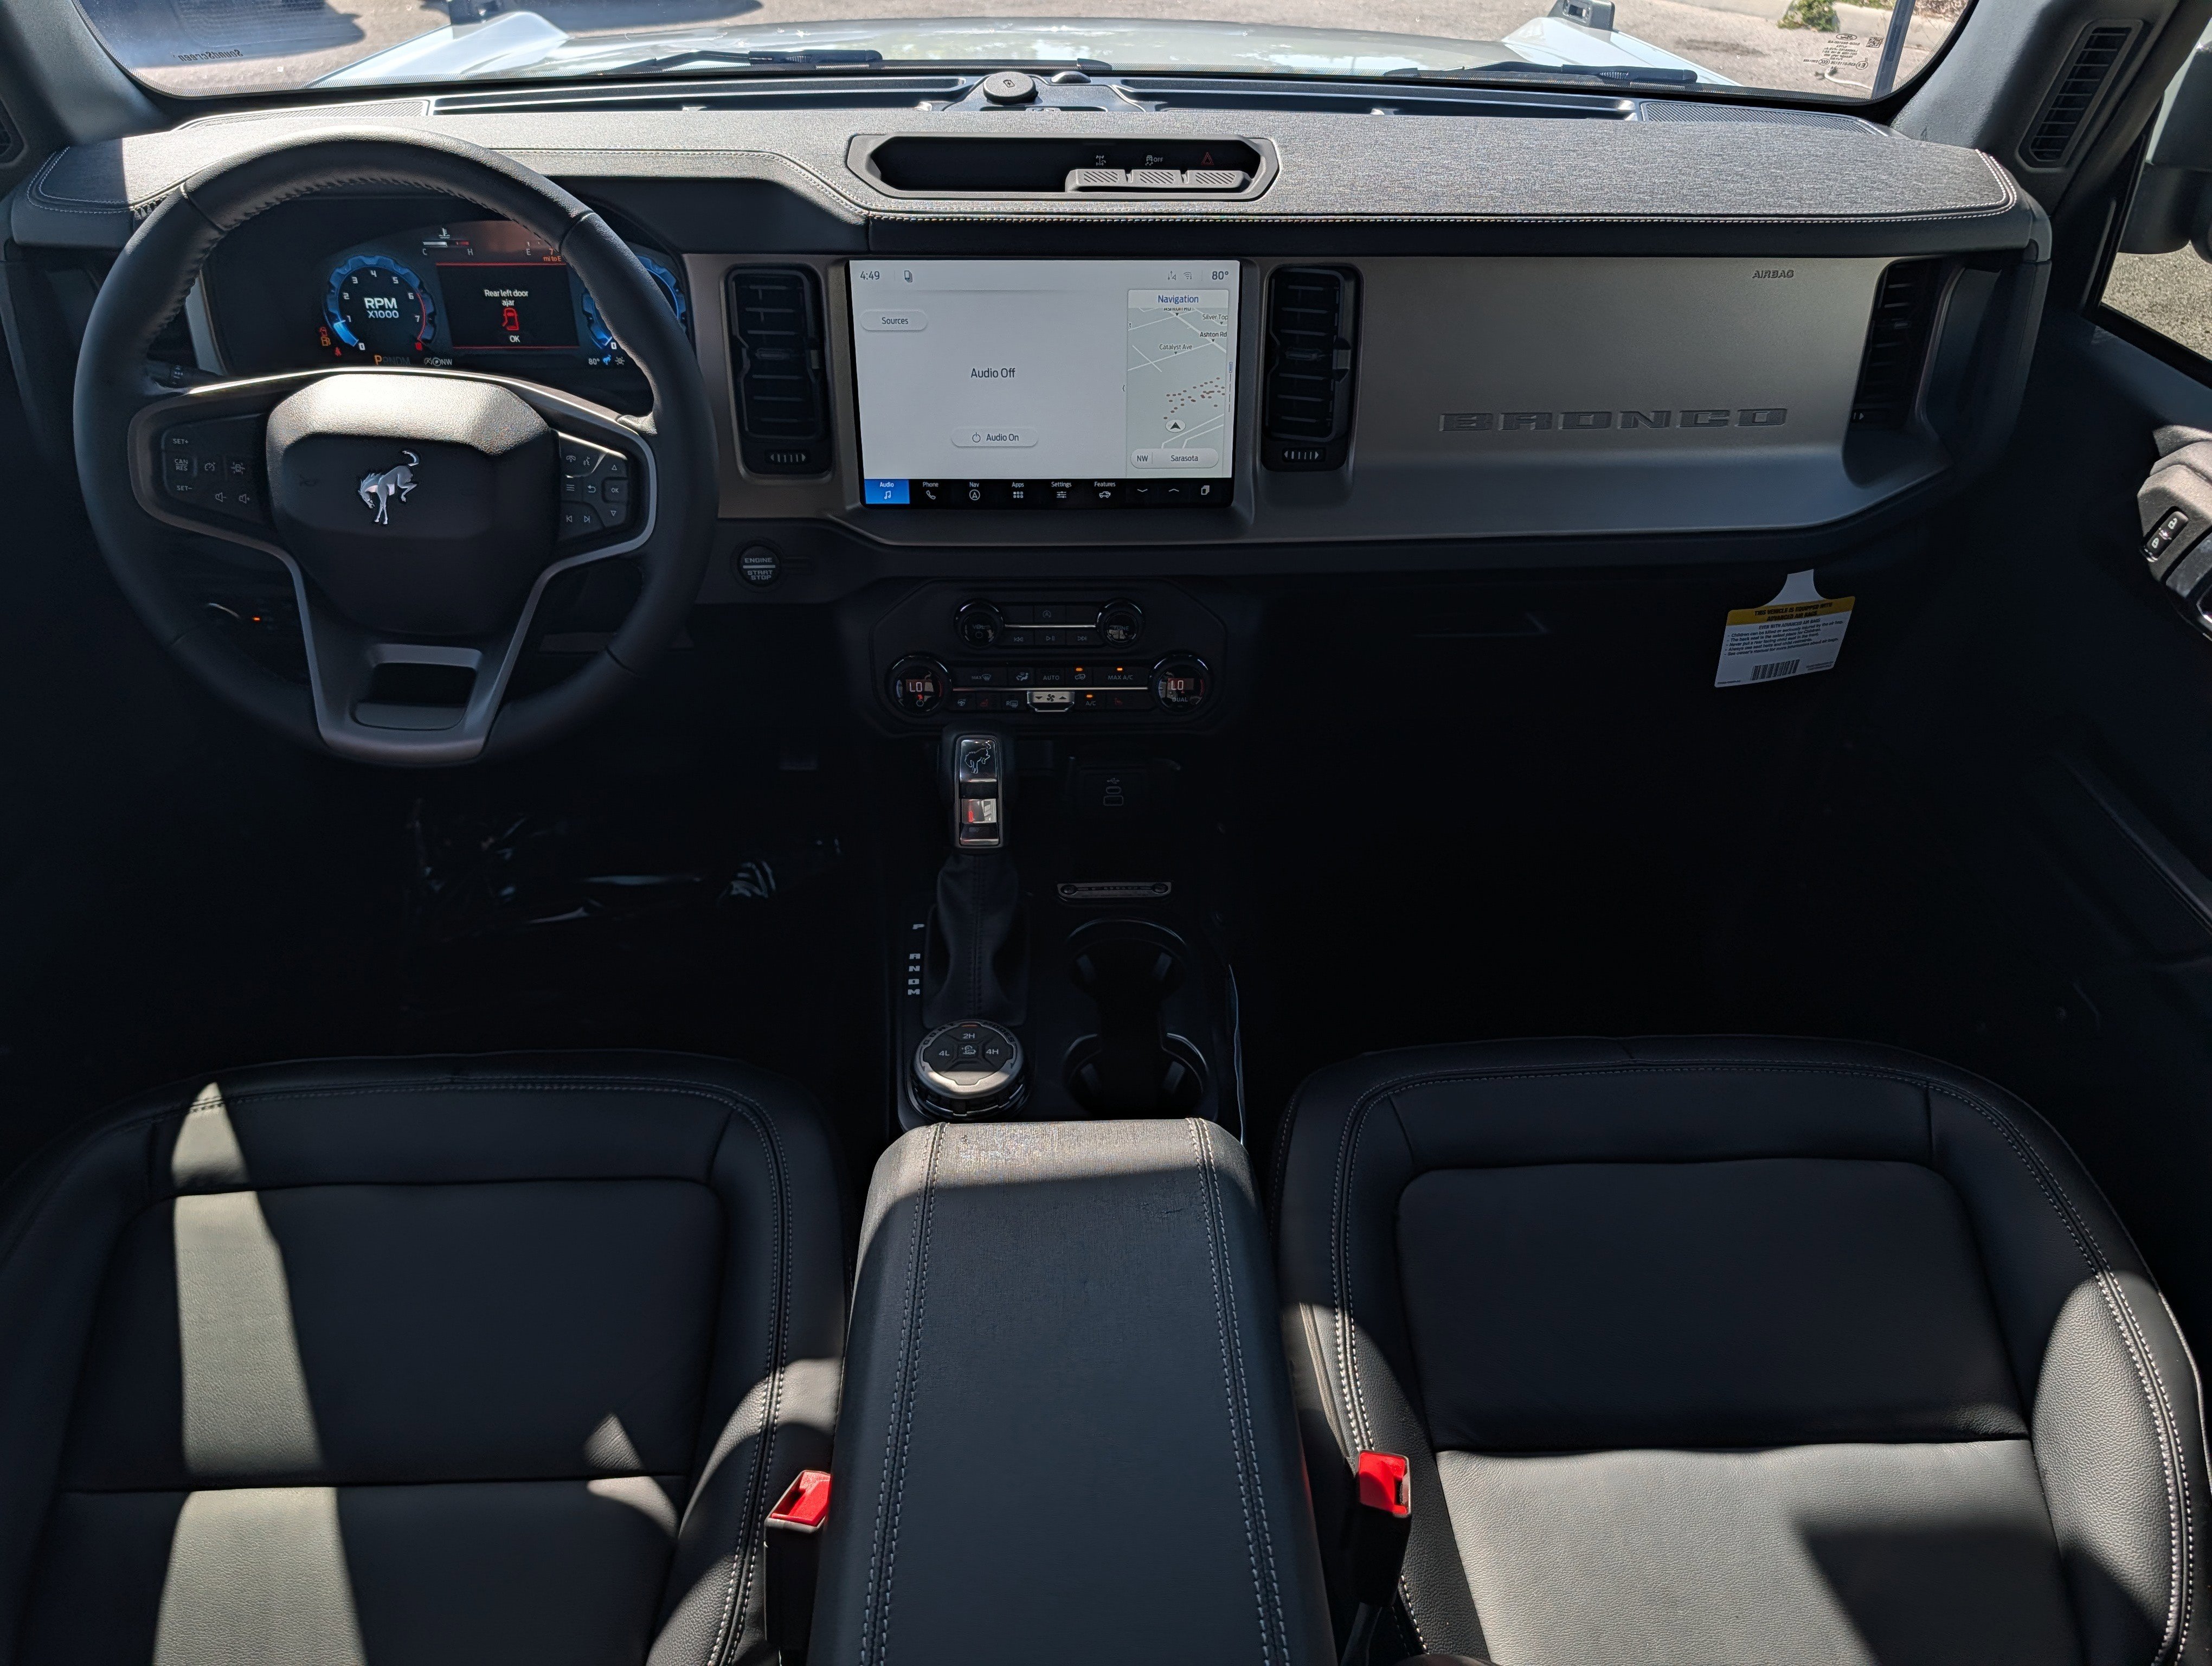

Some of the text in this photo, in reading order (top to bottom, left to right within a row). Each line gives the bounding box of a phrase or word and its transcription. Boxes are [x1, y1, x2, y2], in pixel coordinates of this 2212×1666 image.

[860, 271, 880, 280] 4:49
[1212, 271, 1229, 280] 80°
[1752, 269, 1795, 279] AIRBAG
[364, 298, 397, 309] RPM
[1158, 295, 1199, 305] Navigation
[367, 310, 399, 318] X1000
[970, 368, 1015, 378] Audio Off
[1439, 407, 1787, 432] BRONCO
[910, 682, 923, 693] LO
[1171, 680, 1184, 690] LO
[983, 1022, 1015, 1043] MODES
